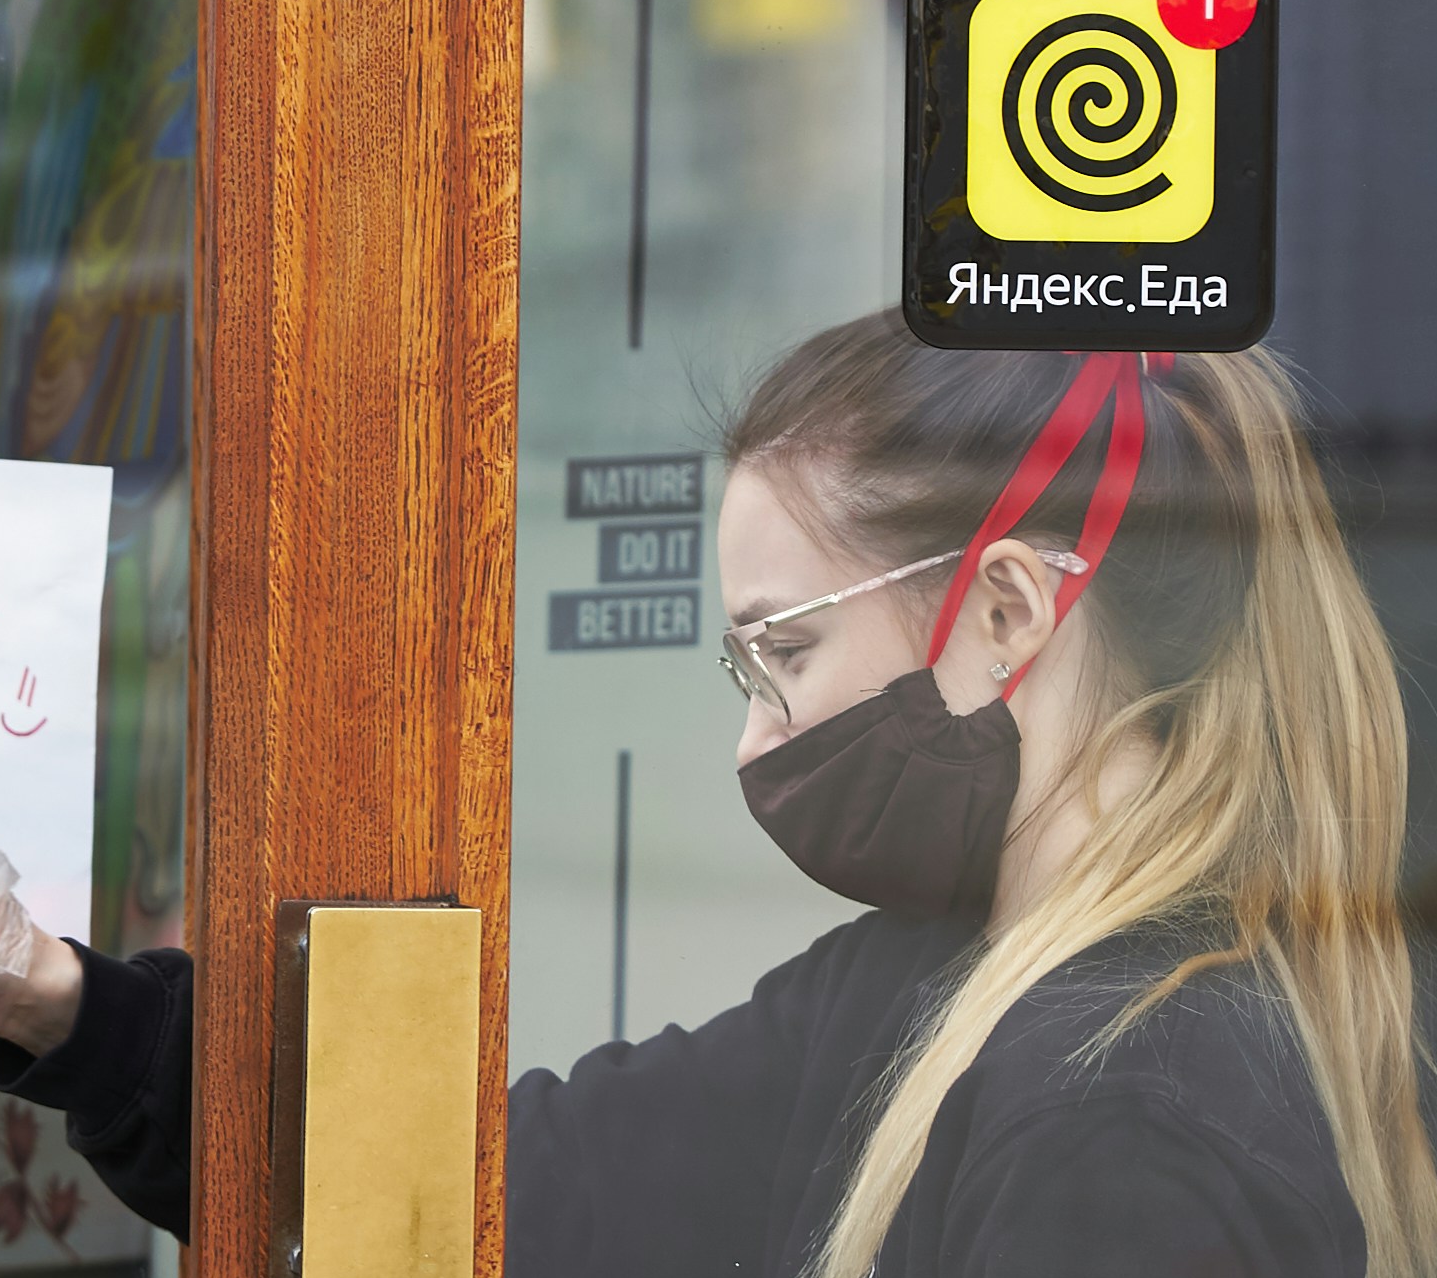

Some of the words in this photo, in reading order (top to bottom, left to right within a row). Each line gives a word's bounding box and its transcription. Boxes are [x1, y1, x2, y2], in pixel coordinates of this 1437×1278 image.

[945, 261, 1229, 316] Яндекс.Еда
[580, 462, 696, 507] NATURE
[618, 530, 660, 573] DO
[665, 528, 696, 571] IT
[577, 595, 694, 643] BETTER
